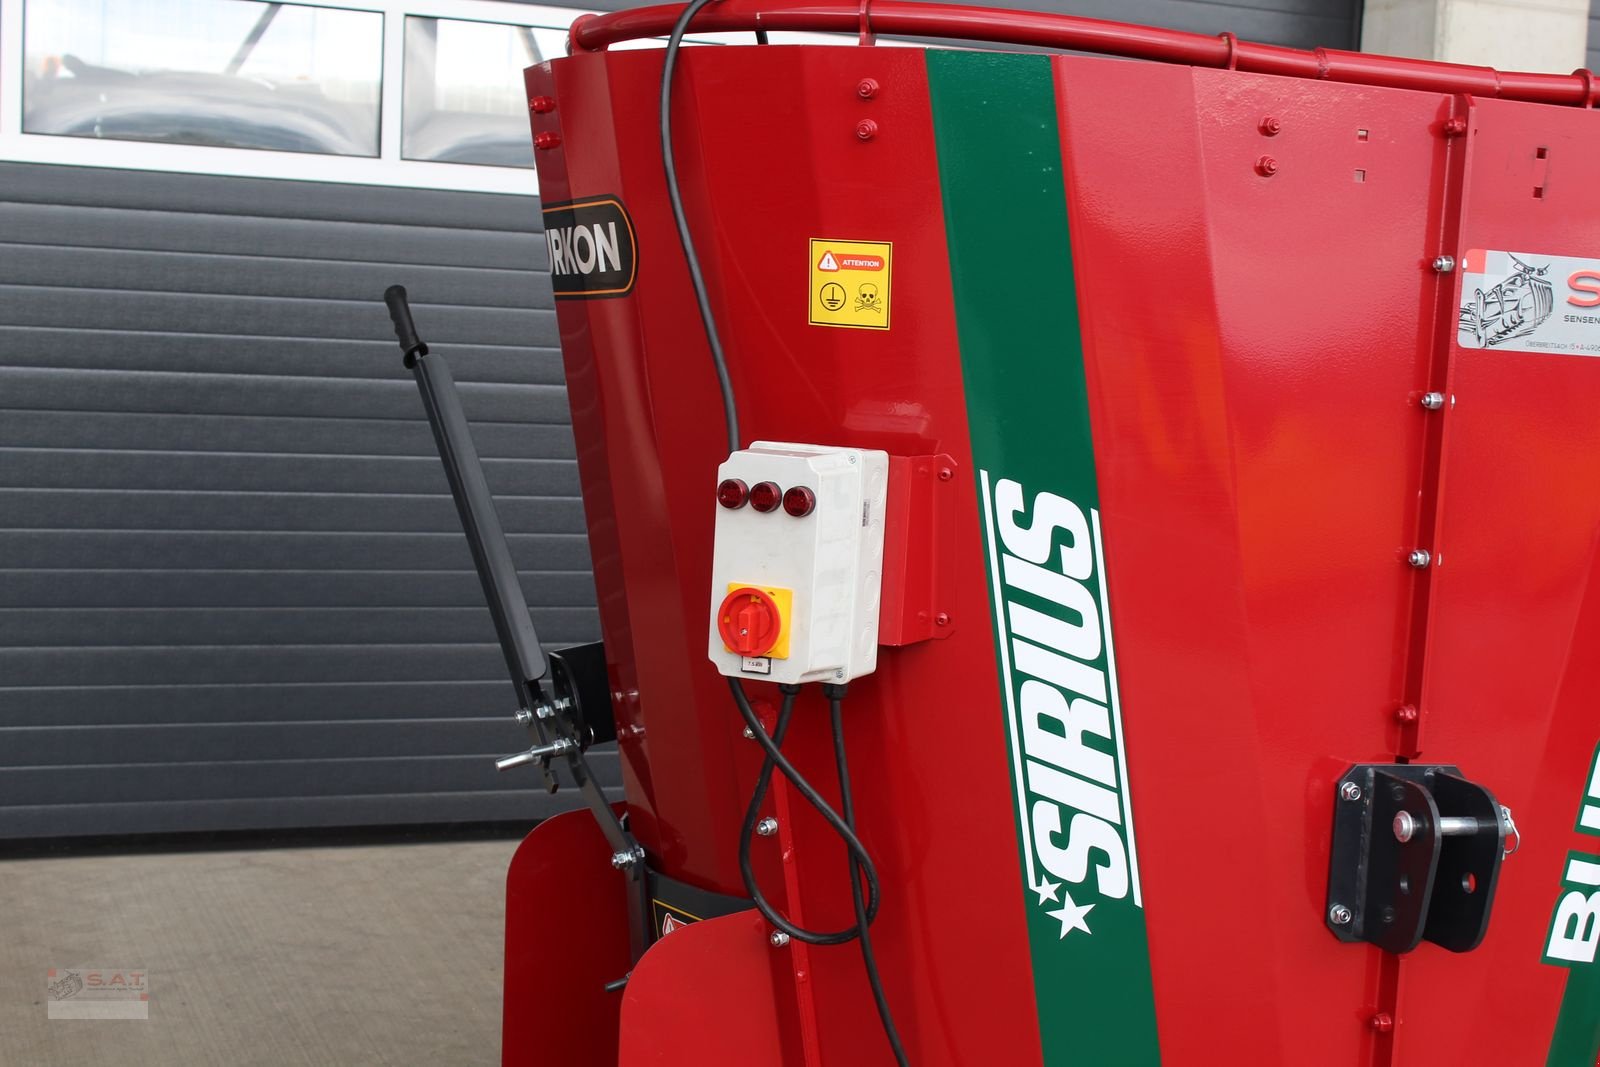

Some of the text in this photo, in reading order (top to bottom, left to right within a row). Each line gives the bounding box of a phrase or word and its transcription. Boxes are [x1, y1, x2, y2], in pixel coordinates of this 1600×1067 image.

[842, 258, 880, 268] ATTENTION
[1564, 315, 1600, 324] SENSEN
[995, 478, 1129, 899] SIRIUS
[1547, 751, 1600, 962] BU
